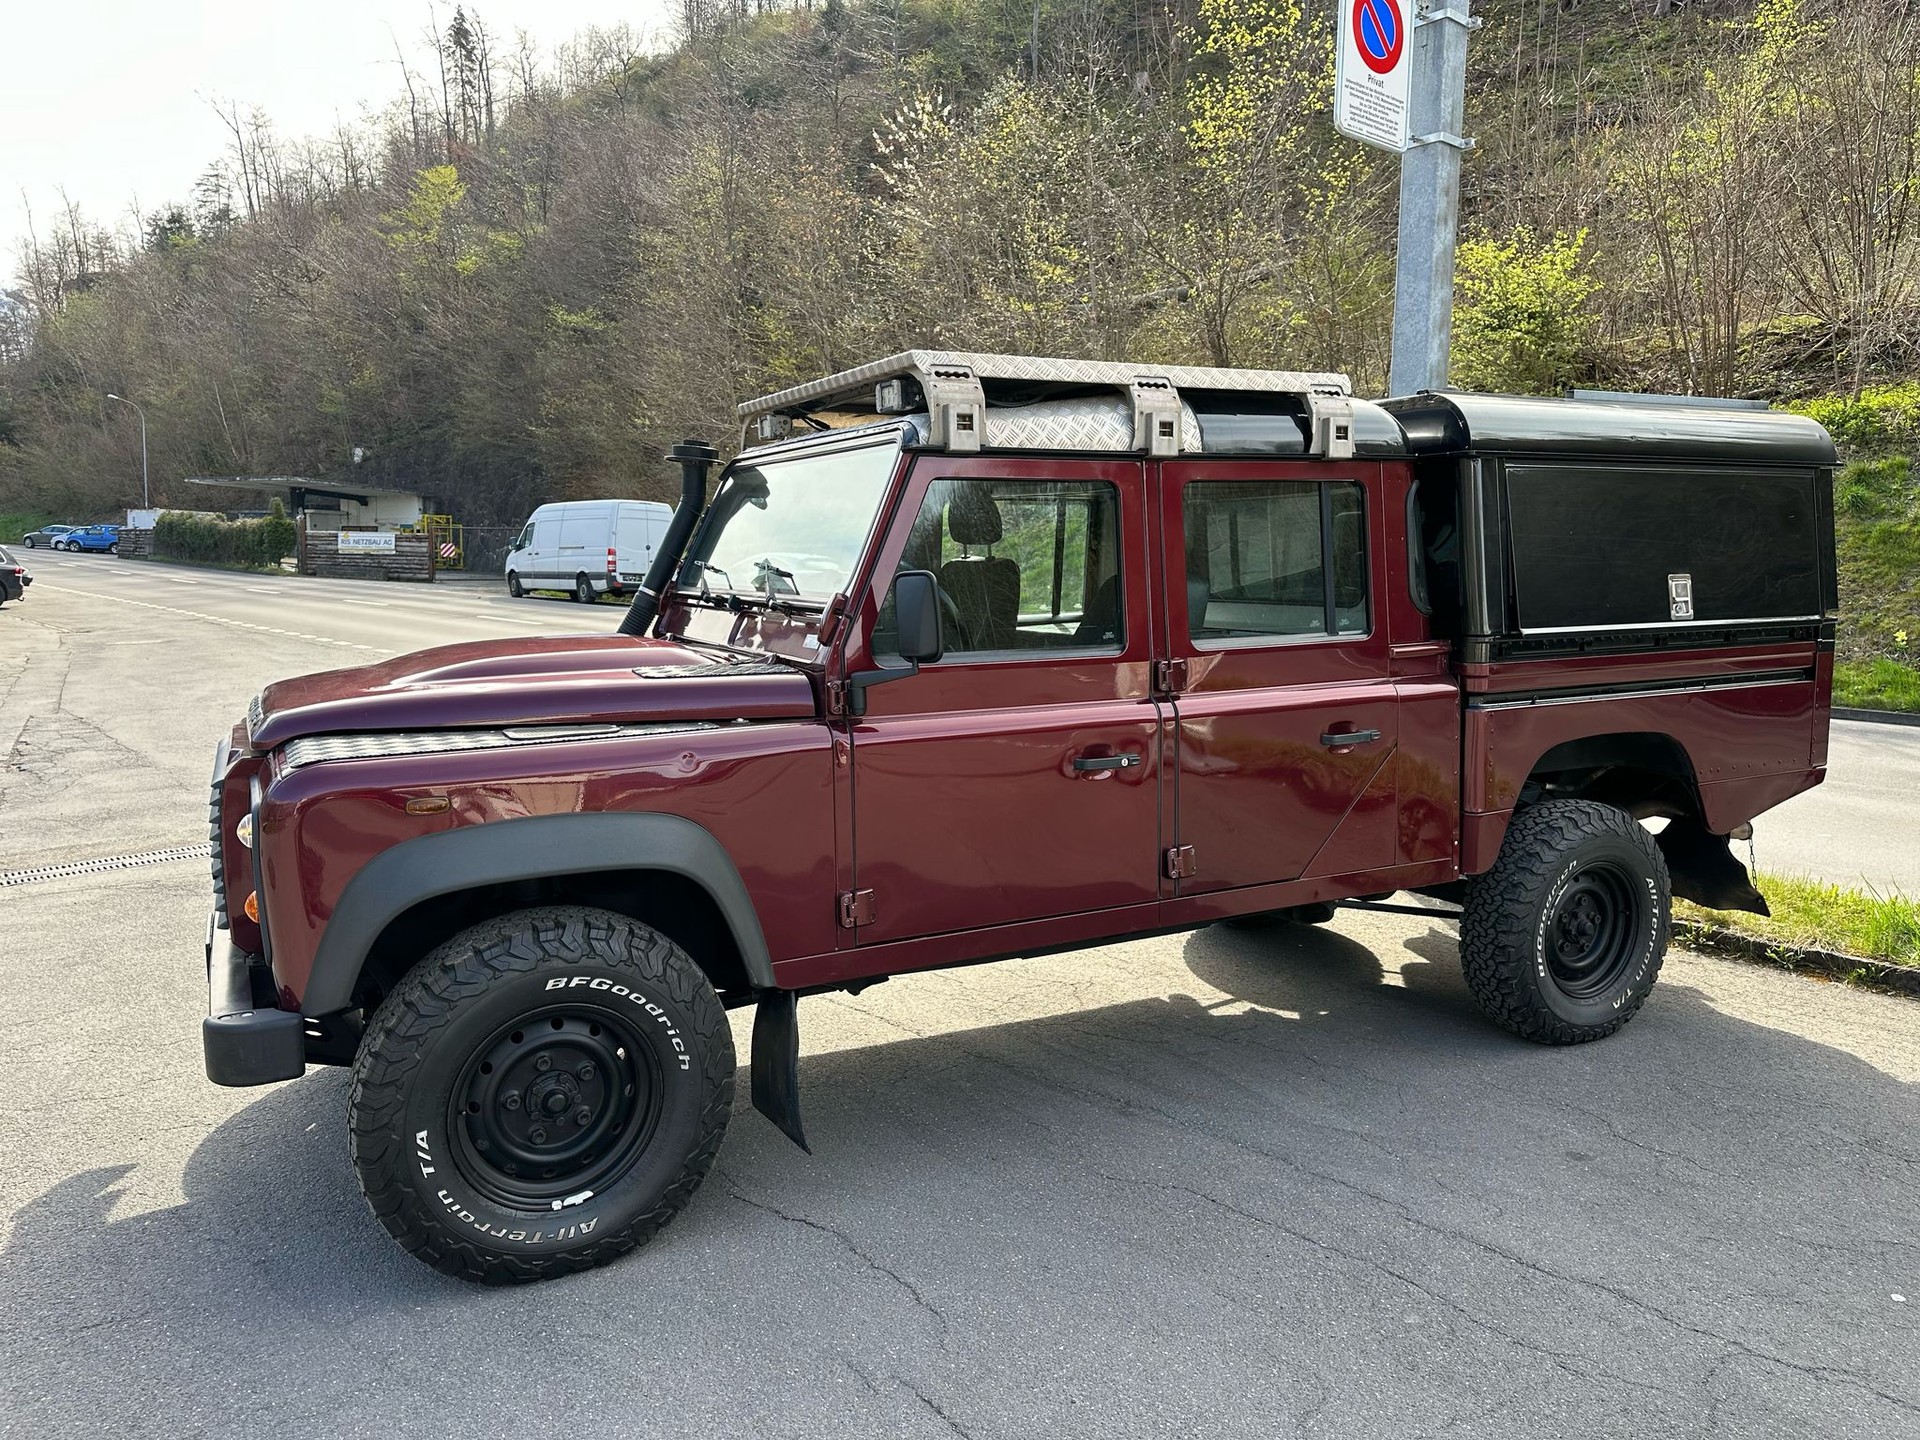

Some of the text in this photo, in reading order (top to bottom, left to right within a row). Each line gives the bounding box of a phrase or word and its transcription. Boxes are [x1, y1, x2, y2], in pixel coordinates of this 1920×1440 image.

[1367, 73, 1384, 89] Privat
[1536, 860, 1577, 977] BFGoodrich
[1612, 877, 1660, 1009] All-Terrain T/A
[545, 976, 690, 1071] BFGoodrich
[416, 1129, 599, 1244] All-Terrain T/A
